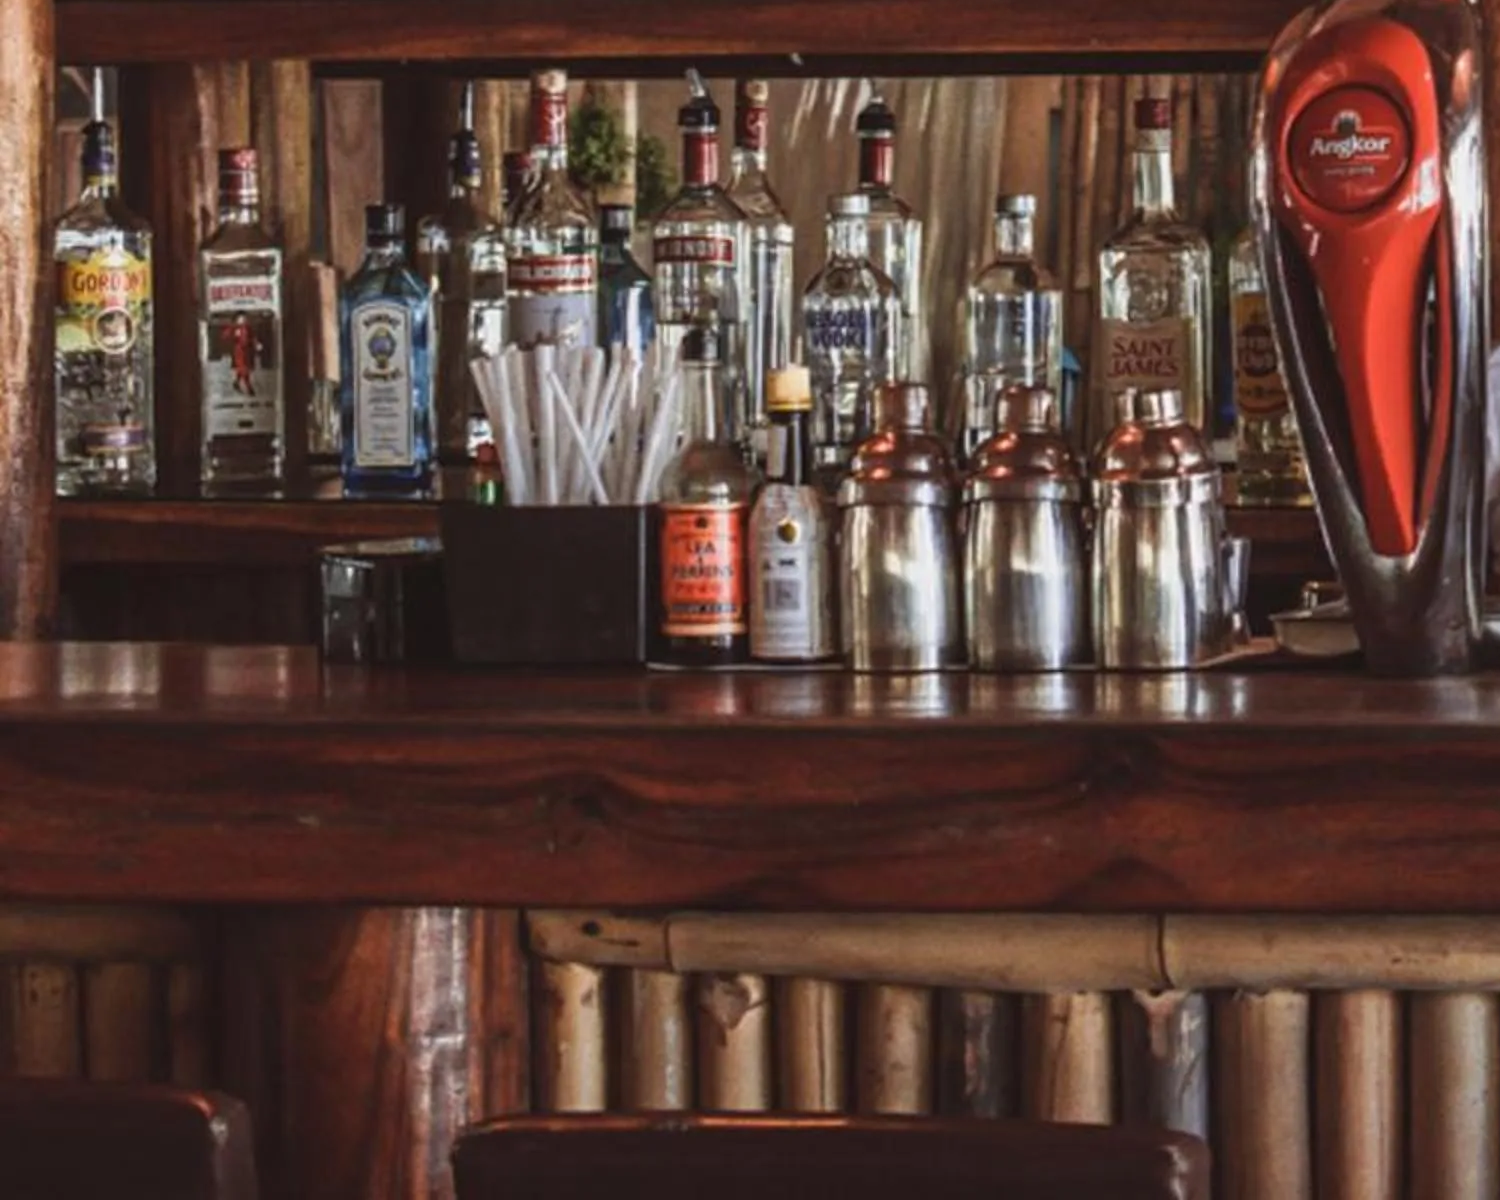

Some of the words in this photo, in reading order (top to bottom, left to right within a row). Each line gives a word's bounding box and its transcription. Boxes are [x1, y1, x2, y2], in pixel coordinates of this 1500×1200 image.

[1311, 135, 1391, 159] Angkor
[1111, 337, 1175, 358] SAINT
[1107, 358, 1179, 378] JAMES
[685, 540, 716, 554] LEA
